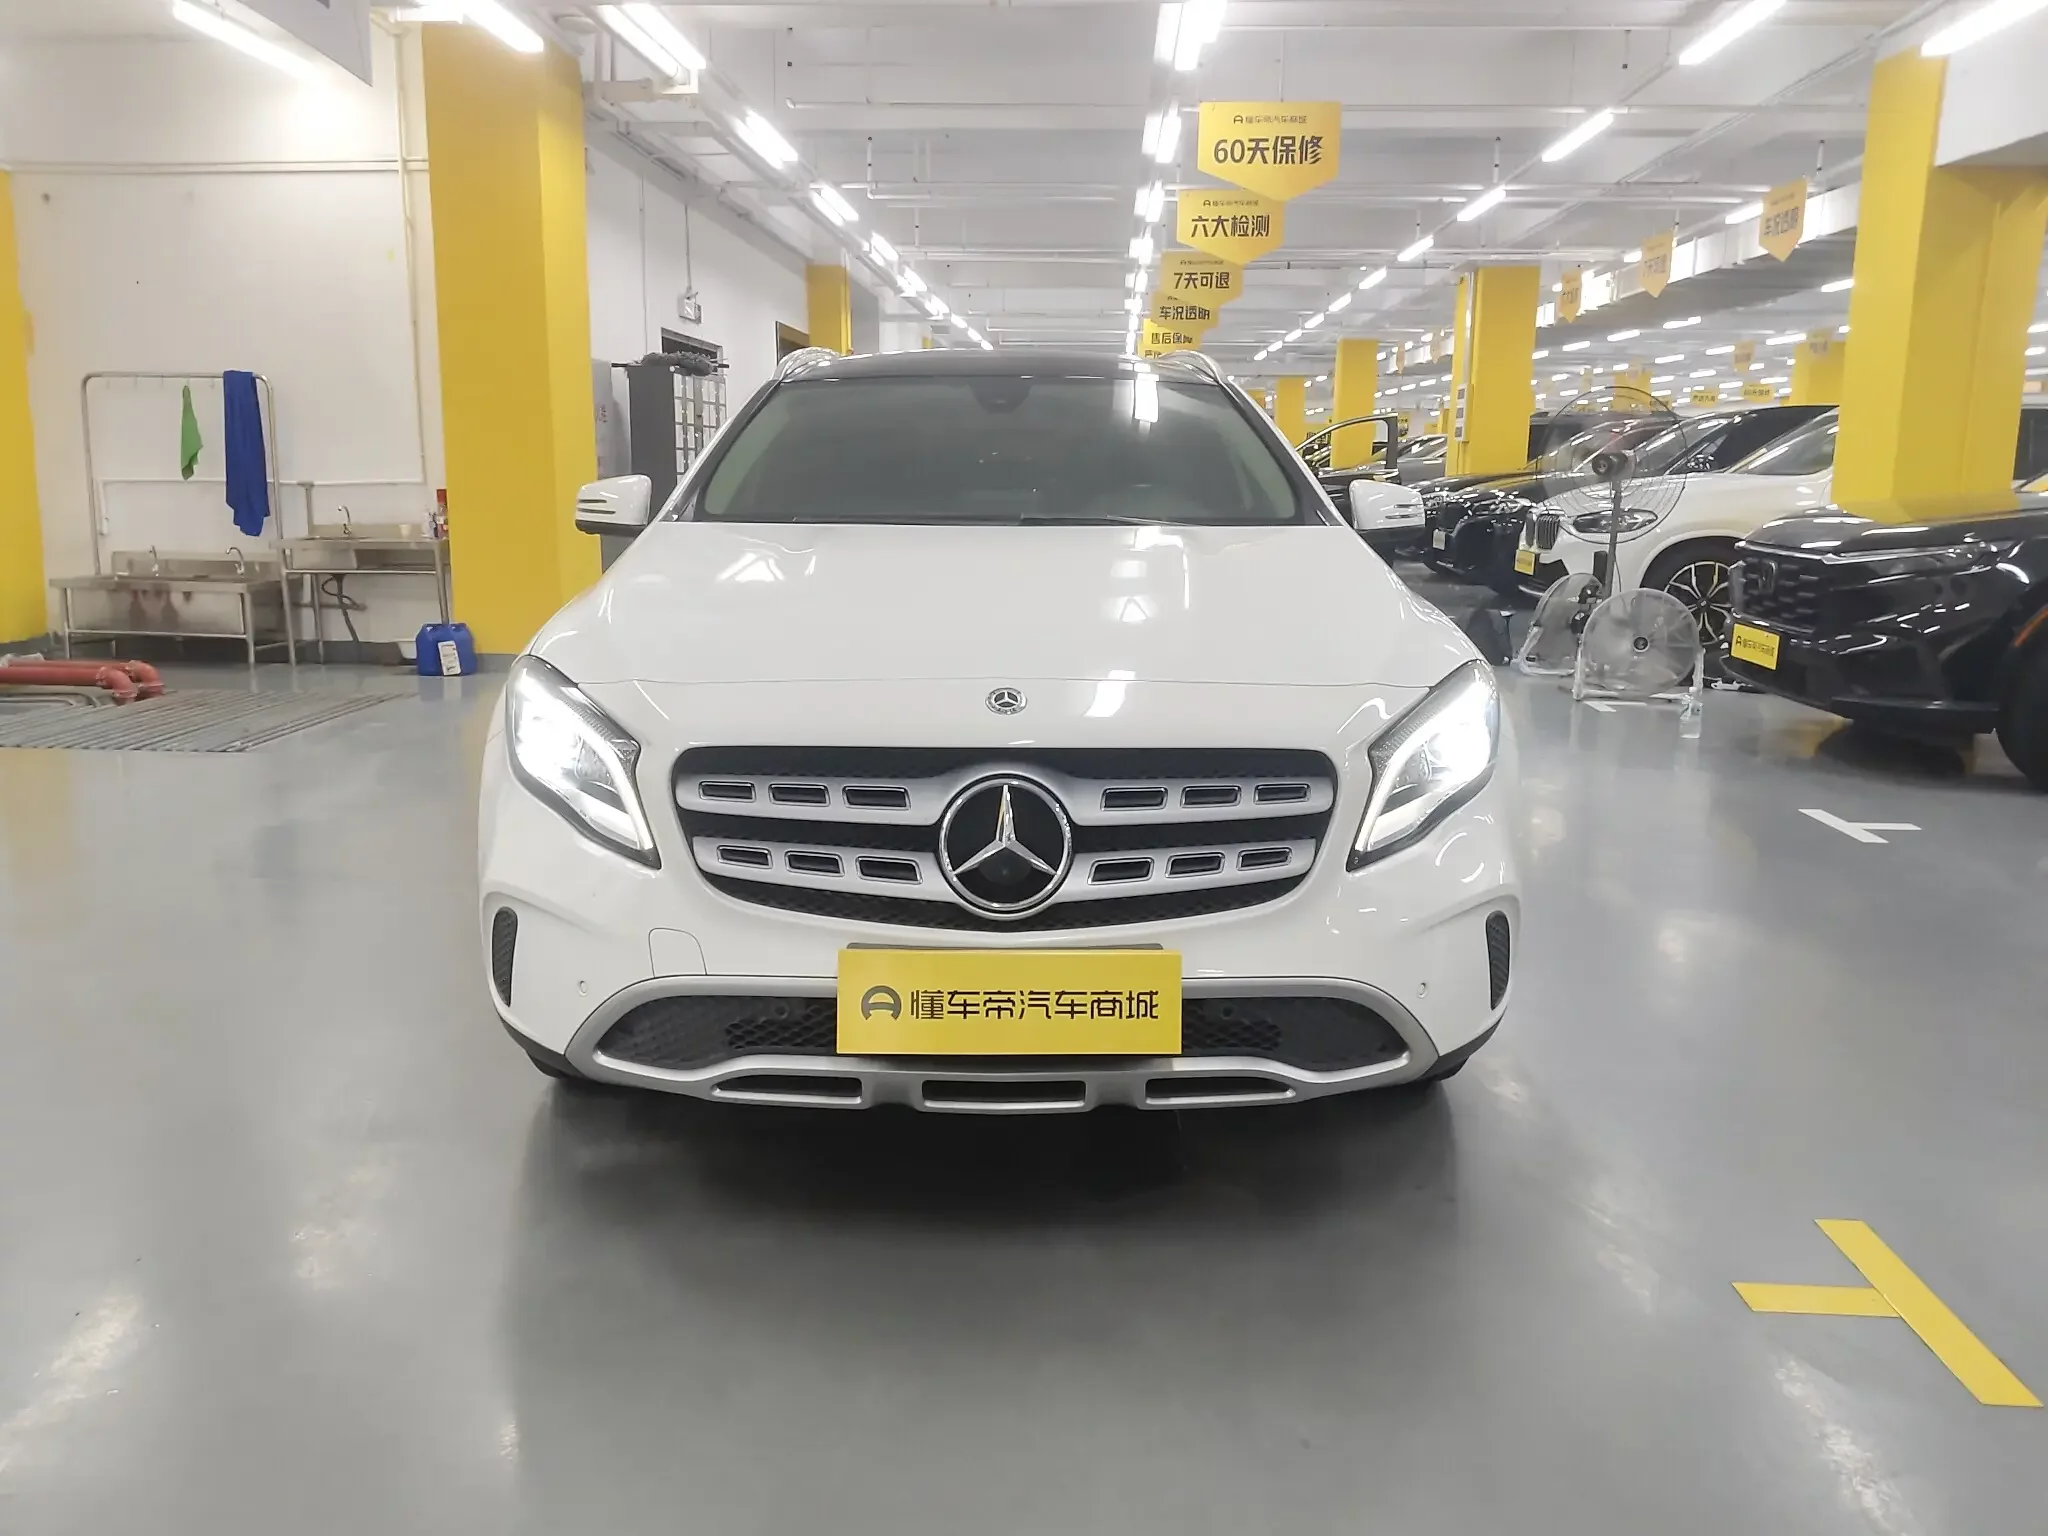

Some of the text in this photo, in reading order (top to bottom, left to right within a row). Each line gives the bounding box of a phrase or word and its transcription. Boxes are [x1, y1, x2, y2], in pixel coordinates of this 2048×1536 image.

[1213, 135, 1324, 165] 60天保修
[1190, 214, 1271, 238] 六大检测
[1173, 271, 1230, 290] 7天可退
[1159, 305, 1211, 321] 车况透明
[909, 989, 1160, 1020] 懂车帝汽车商城
